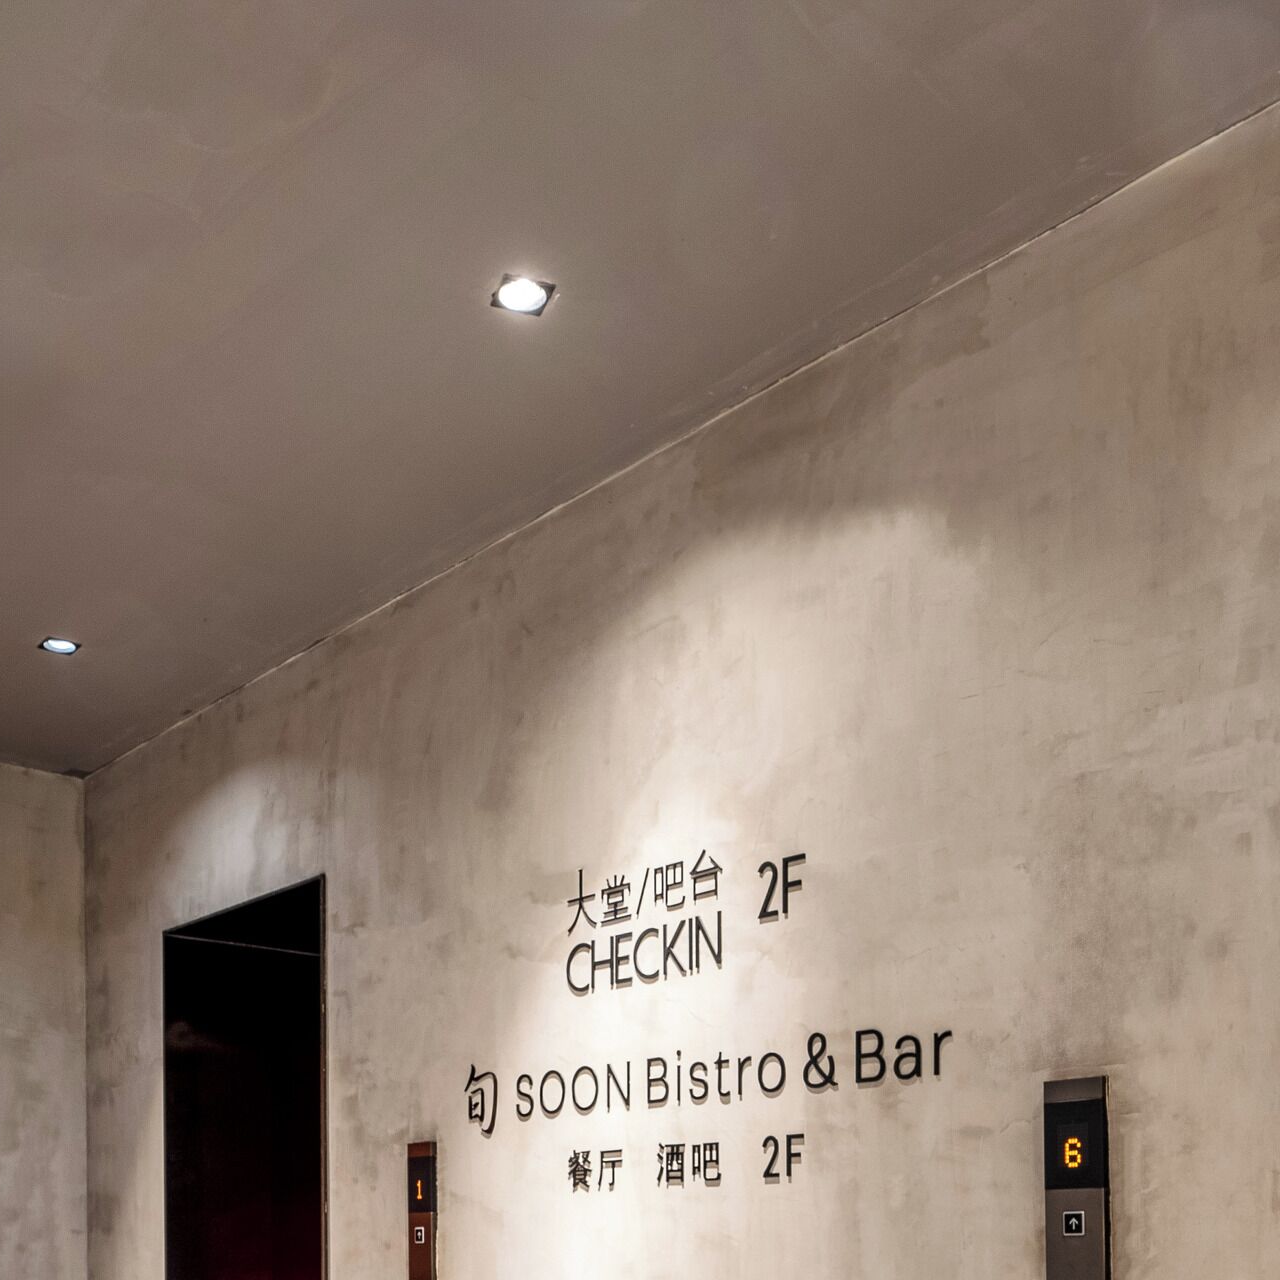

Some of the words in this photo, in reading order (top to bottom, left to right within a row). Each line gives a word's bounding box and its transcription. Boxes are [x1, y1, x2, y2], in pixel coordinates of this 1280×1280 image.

[568, 849, 723, 934] 大堂/吧台
[758, 853, 806, 921] 2F
[566, 911, 723, 994] CHECKIN
[464, 1063, 498, 1135] 旬
[516, 1061, 631, 1118] SOON
[647, 1050, 786, 1106] Bistro
[803, 1032, 839, 1090] &
[855, 1029, 953, 1085] Bar
[568, 1149, 623, 1190] 餐厅
[657, 1142, 721, 1186] 酒吧
[762, 1133, 805, 1179] 2F
[1064, 1137, 1082, 1168] 6
[416, 1179, 423, 1200] 1
